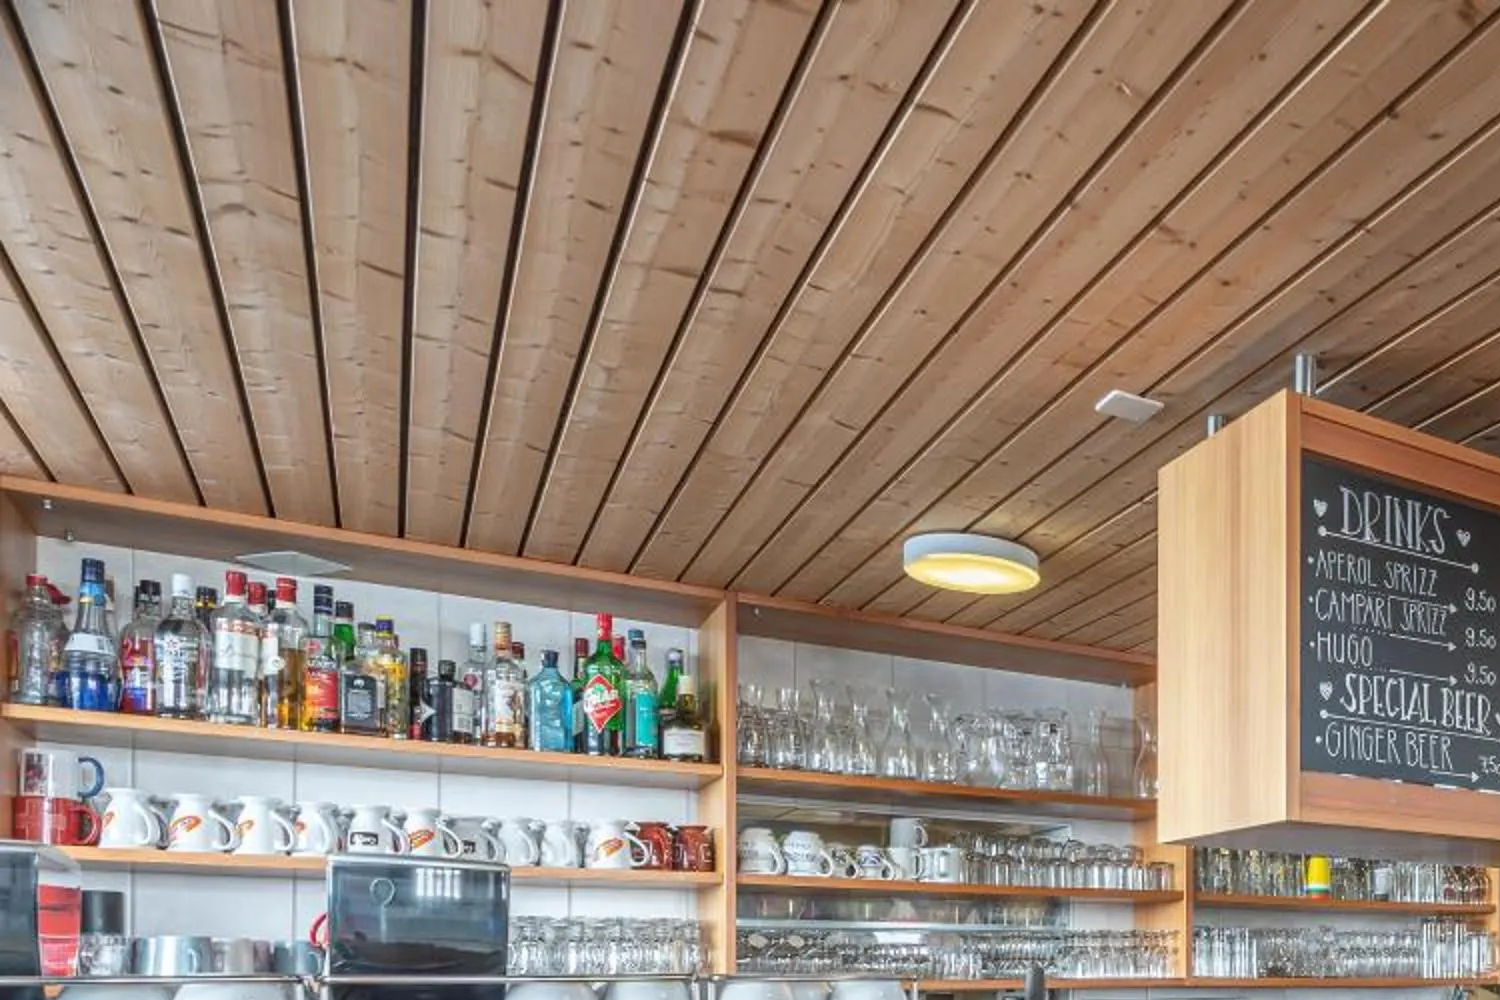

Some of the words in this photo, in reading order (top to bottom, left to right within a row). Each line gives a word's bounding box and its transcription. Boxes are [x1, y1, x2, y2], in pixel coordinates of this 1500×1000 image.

[1339, 485, 1451, 554] DRINKS
[1315, 549, 1377, 587] APEROL
[1384, 561, 1438, 597] SPRIZZ
[1315, 587, 1392, 629] CAMPARI
[1317, 631, 1373, 667] HUGO
[1340, 672, 1437, 726] SPECIAL
[1441, 687, 1491, 736] BEER
[1325, 722, 1400, 765] GINGER
[1405, 731, 1453, 771] BEER
